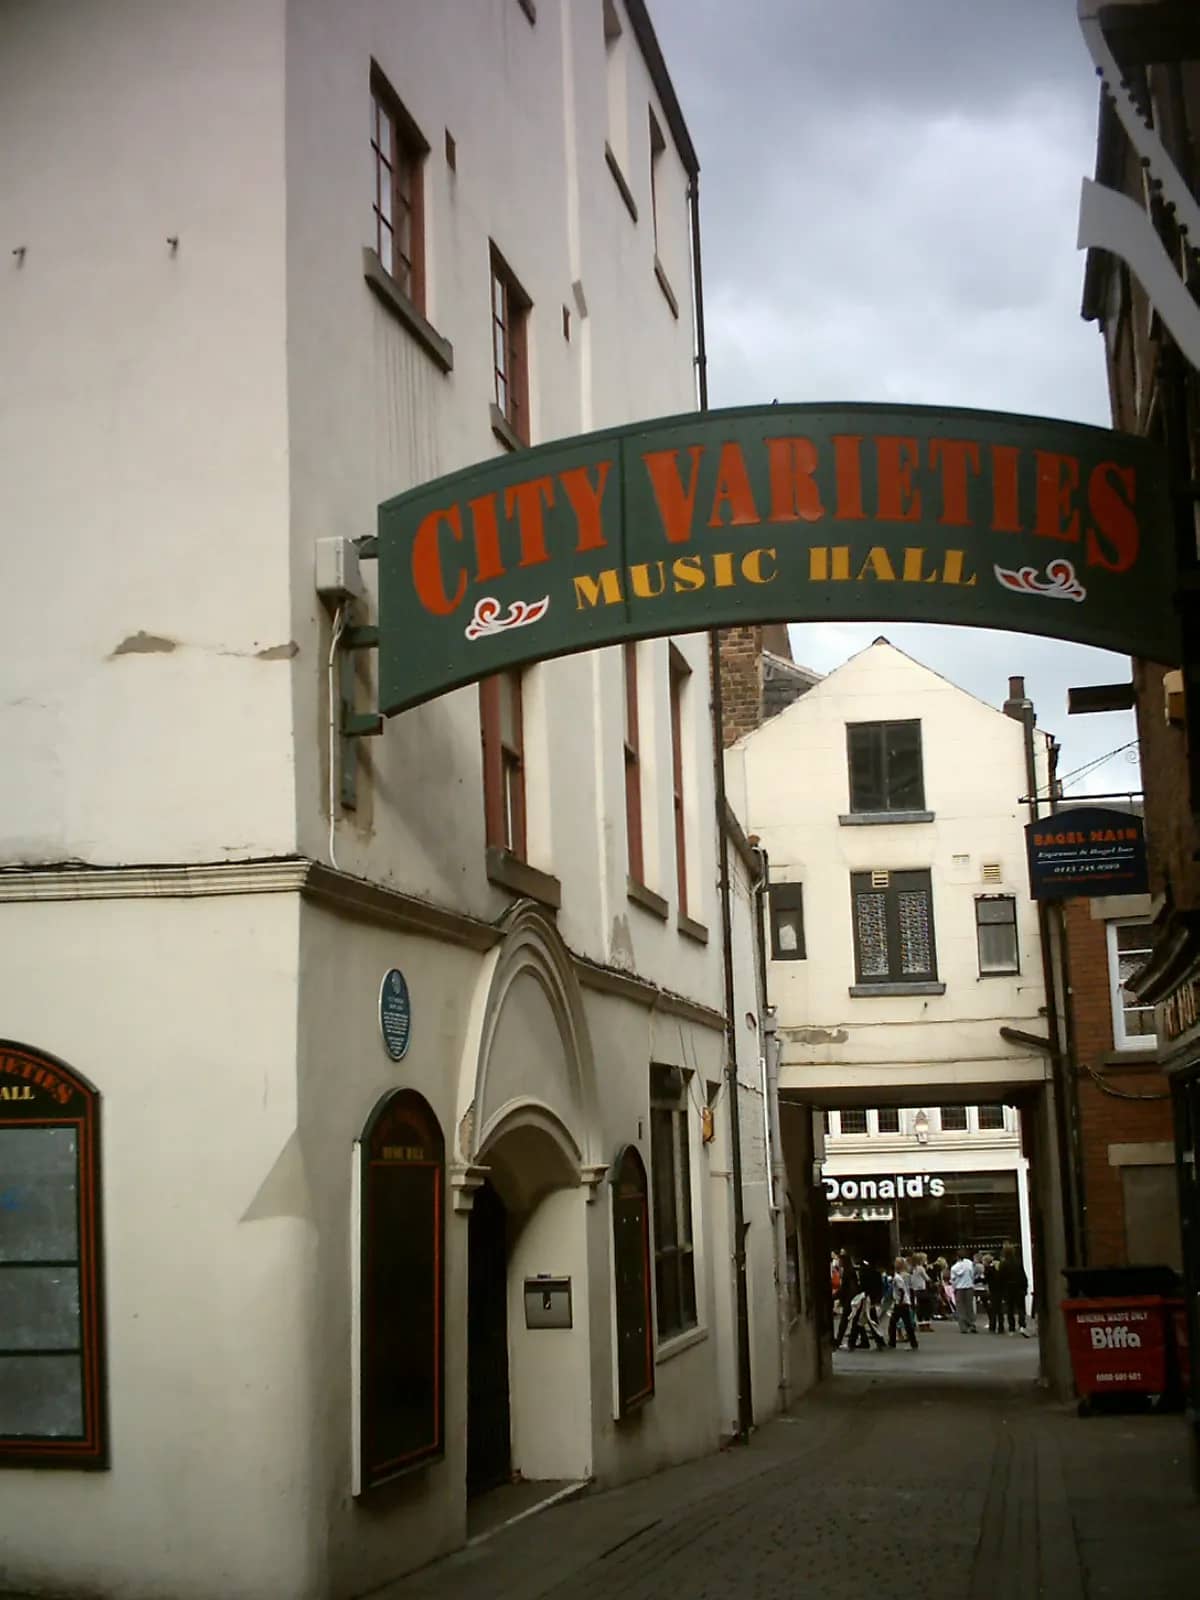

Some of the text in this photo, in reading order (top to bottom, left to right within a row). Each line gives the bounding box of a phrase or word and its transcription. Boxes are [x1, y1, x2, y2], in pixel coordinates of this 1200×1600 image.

[411, 434, 1140, 616] CITY VARIETIES
[573, 545, 978, 611] MUSIC HALL
[821, 1175, 945, 1201] Donald's
[1090, 1326, 1142, 1350] Biffa
